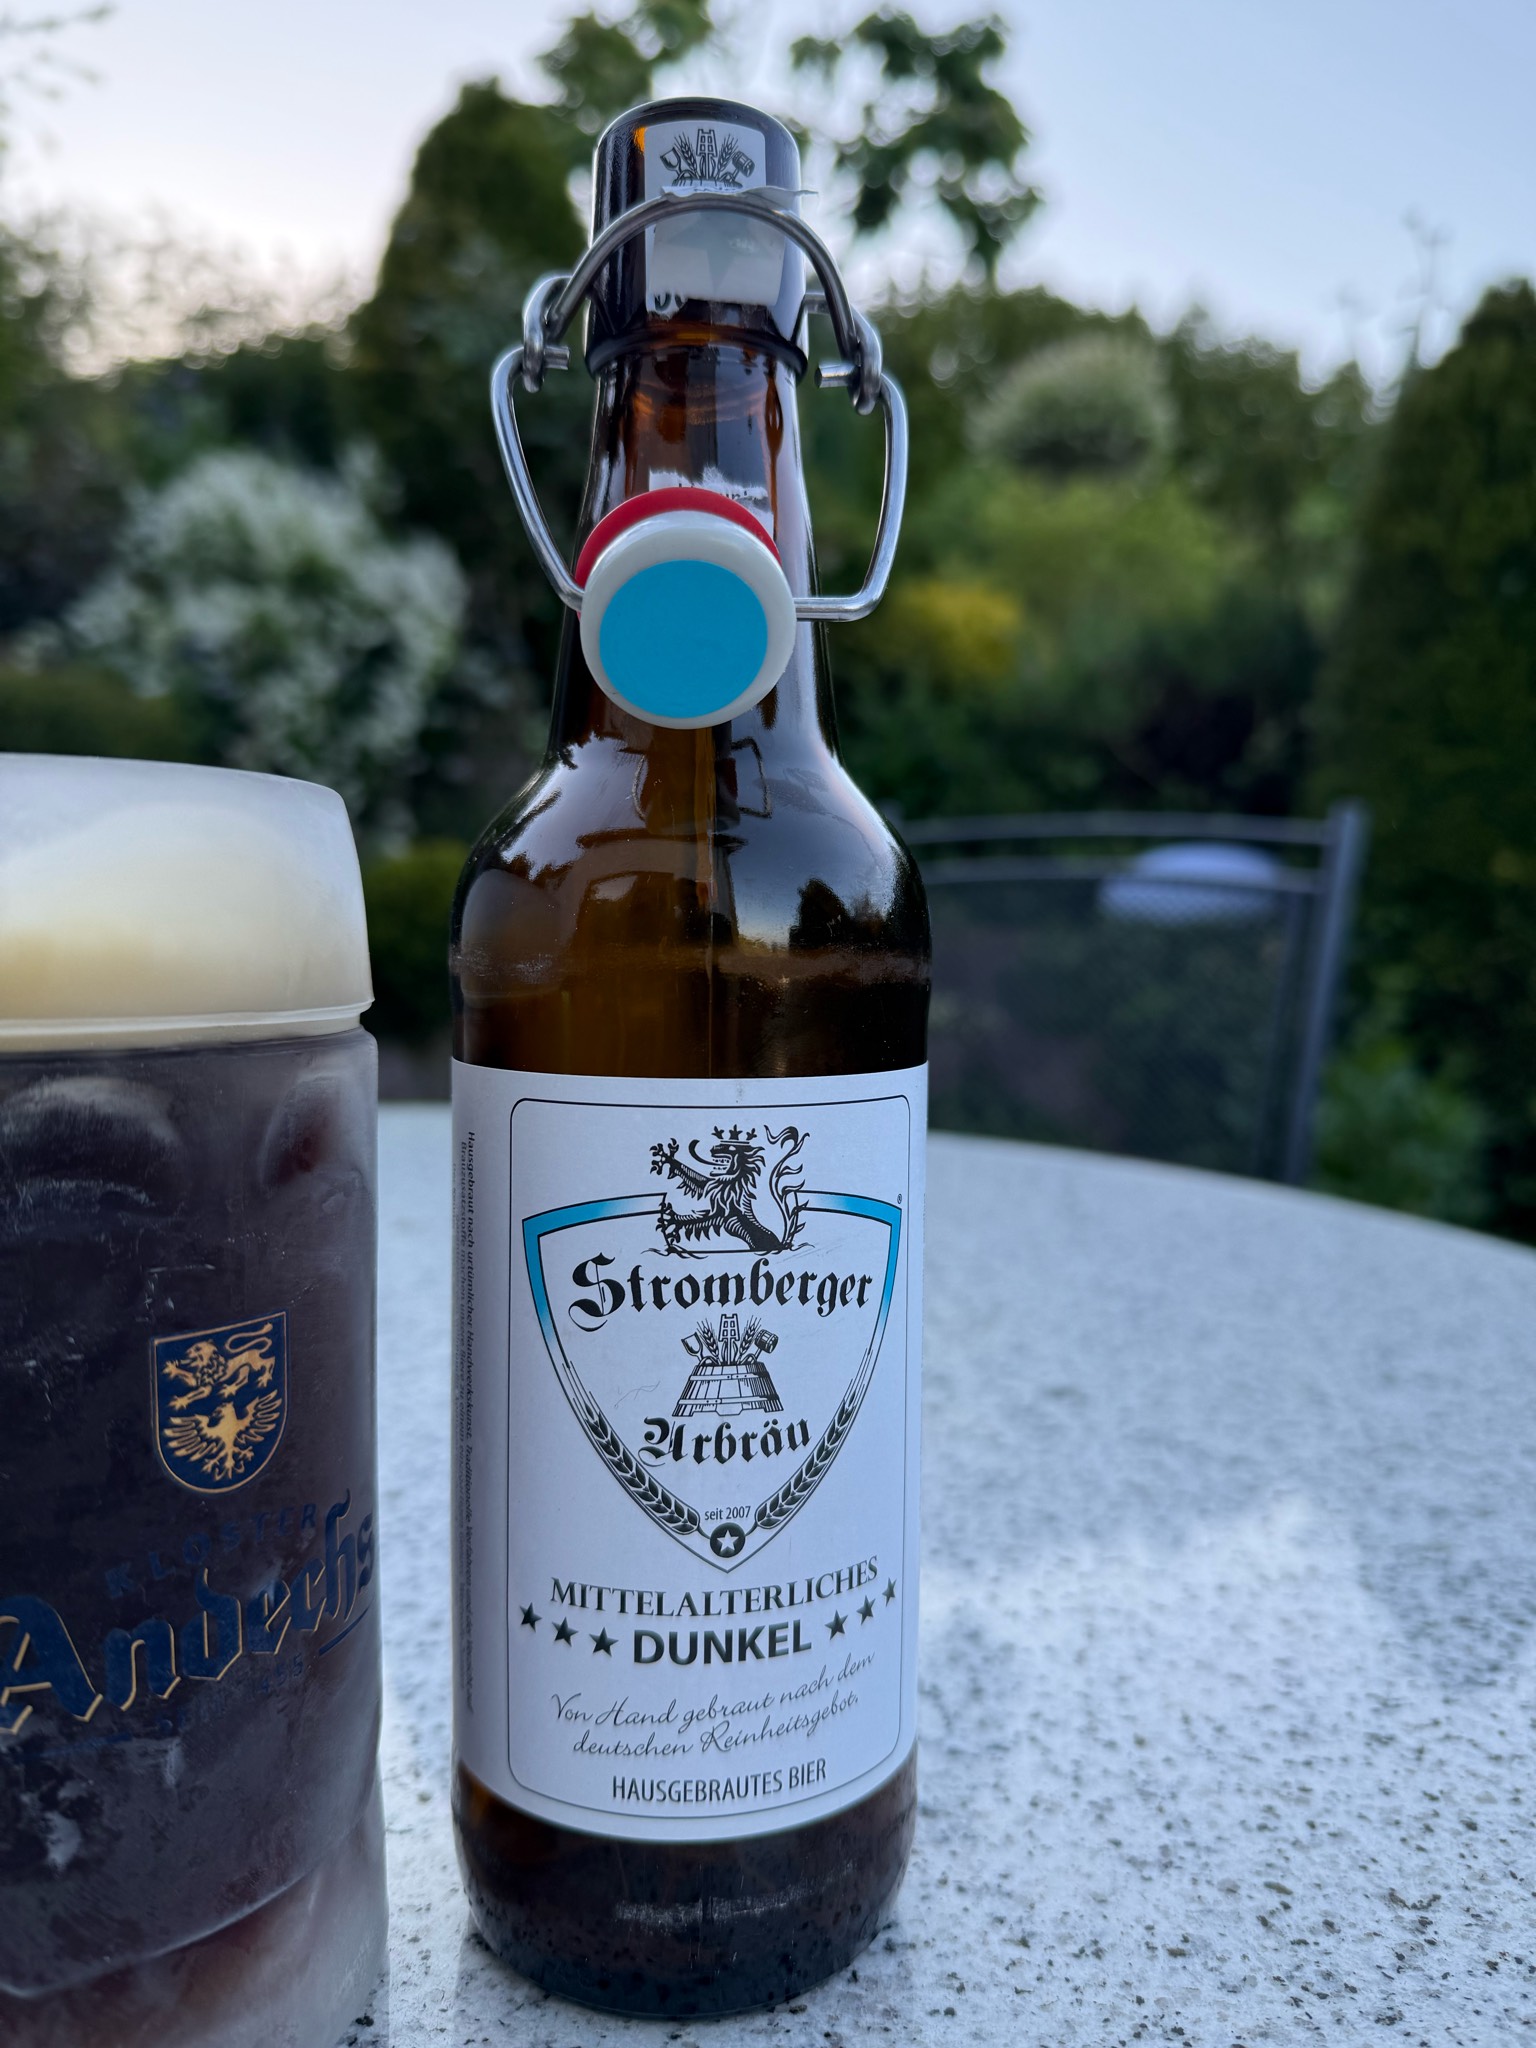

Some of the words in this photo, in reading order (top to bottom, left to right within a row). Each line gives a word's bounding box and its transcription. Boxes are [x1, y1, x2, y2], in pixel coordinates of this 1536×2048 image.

[467, 1131, 475, 1214] Hausgebraut
[467, 1251, 475, 1329] urtümlicher
[568, 1252, 873, 1332] Stromberger
[466, 1330, 475, 1440] Handwerkskunst.
[638, 1416, 812, 1467] Urbräu
[465, 1444, 473, 1523] Traditionelle
[704, 1507, 724, 1521] seit
[725, 1505, 752, 1520] 2007
[104, 1502, 318, 1599] KLOSTER
[550, 1555, 878, 1618] MITTELALTERLICHES
[633, 1619, 813, 1666] DUNKEL
[551, 1692, 593, 1723] Von
[595, 1695, 679, 1727] Hand
[677, 1694, 775, 1734] gebraut
[779, 1664, 834, 1705] nach
[836, 1651, 875, 1683] dem
[572, 1730, 694, 1757] deutschen
[699, 1690, 860, 1752] Reinheitsgebot.
[611, 1769, 783, 1802] HAUSGEBRAUTES
[788, 1757, 827, 1790] BIER
